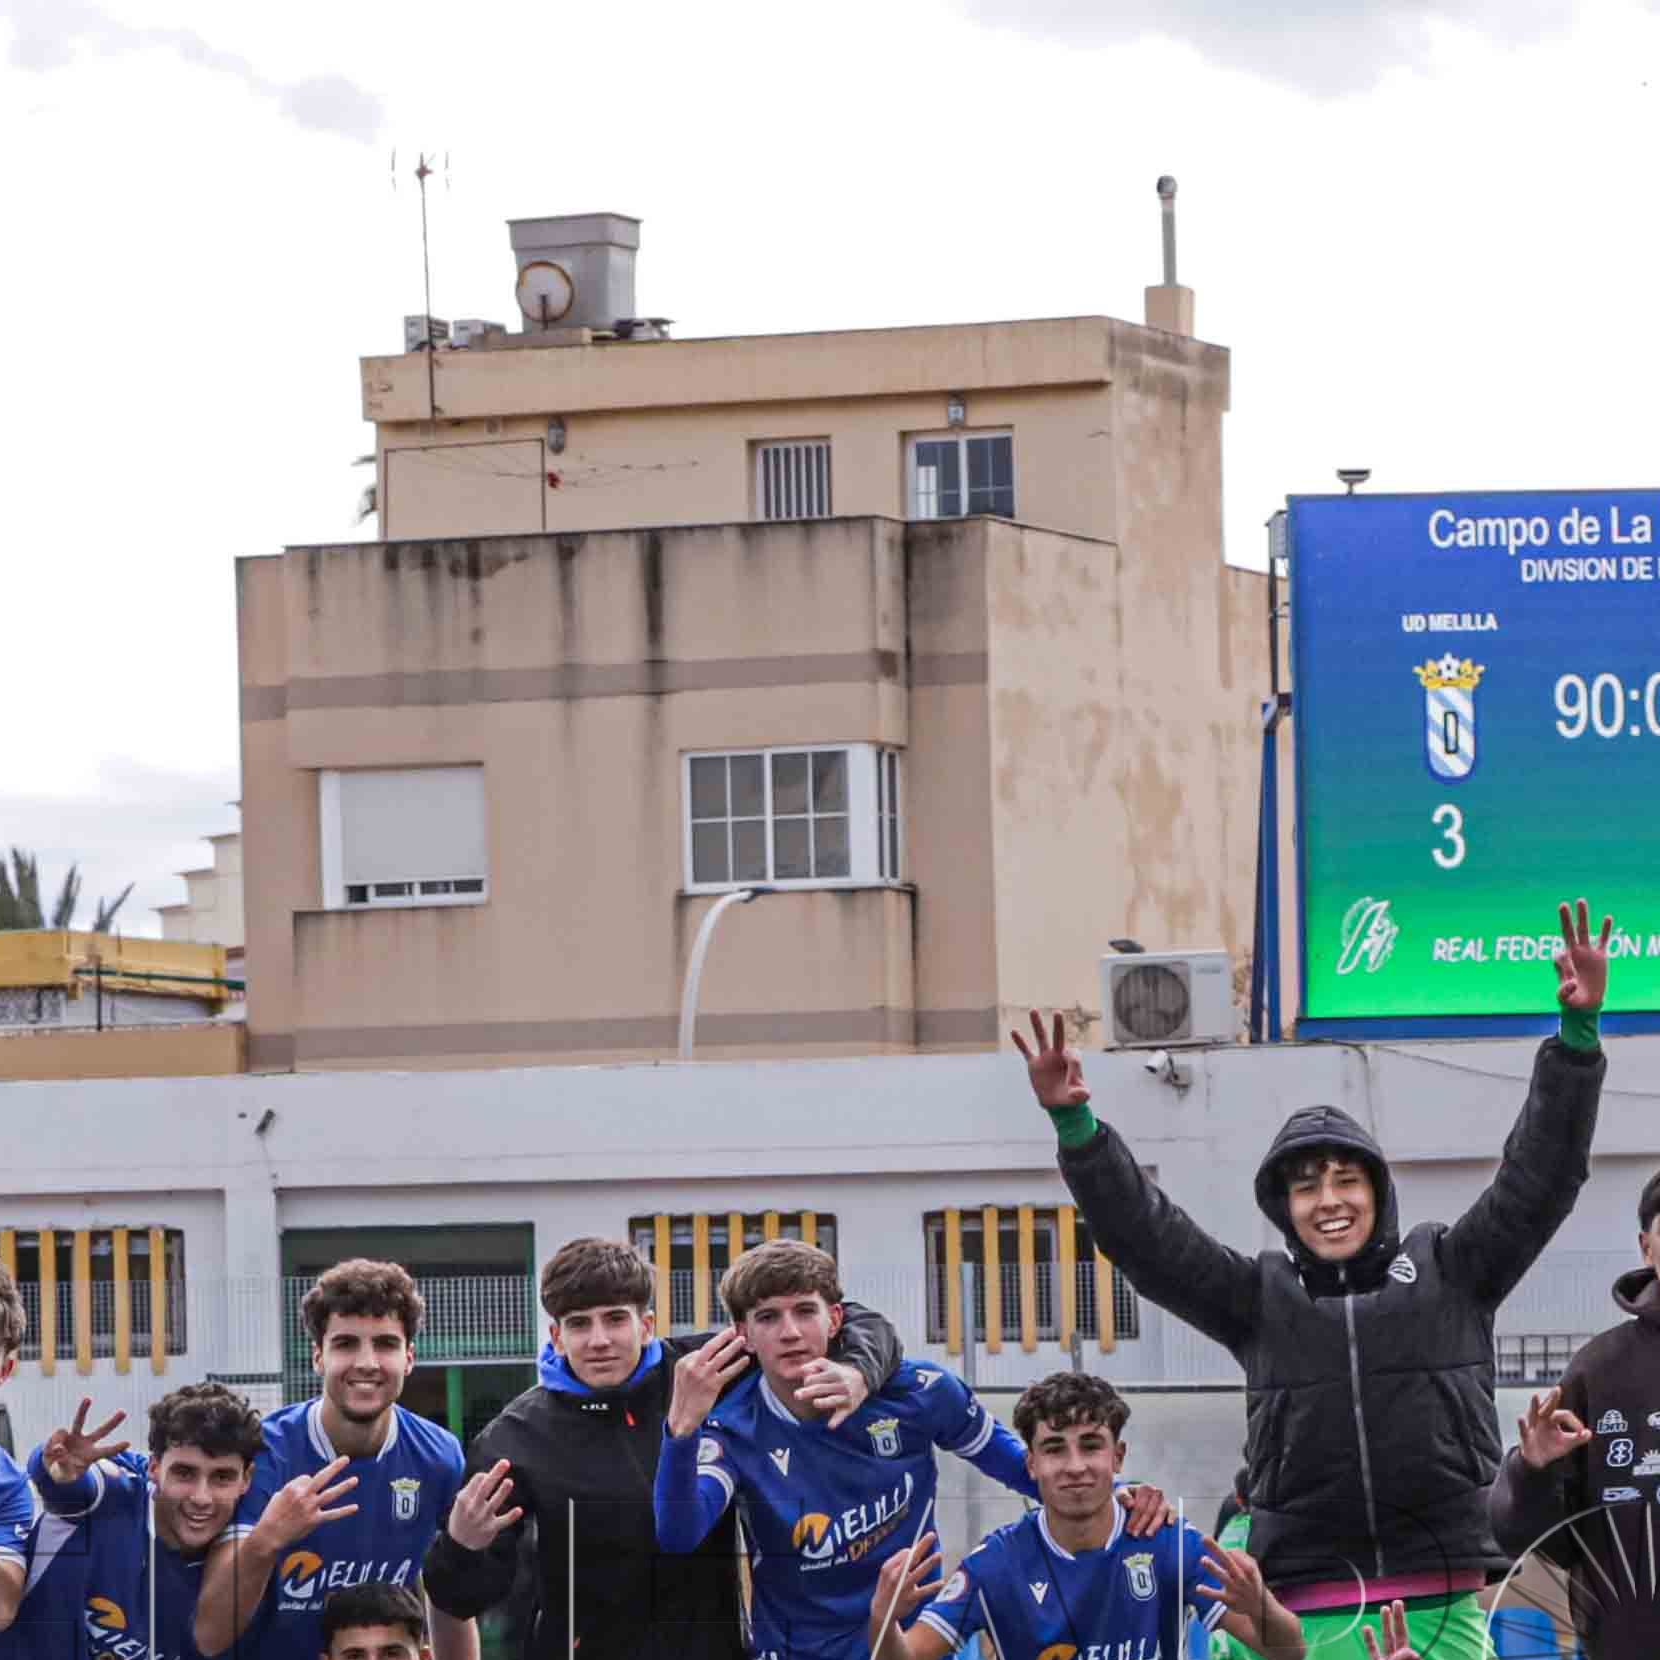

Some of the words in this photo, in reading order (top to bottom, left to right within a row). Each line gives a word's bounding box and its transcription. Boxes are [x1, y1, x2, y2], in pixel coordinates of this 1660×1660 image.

[1428, 508, 1549, 555] Campo
[1558, 507, 1601, 546] de
[1611, 505, 1652, 544] La
[1521, 556, 1617, 583] DIVISION
[1622, 555, 1653, 581] DE
[1402, 612, 1427, 632] UD
[1428, 611, 1499, 632] MELILLA
[1432, 803, 1466, 869] 3
[1433, 935, 1489, 963] REAL
[1495, 928, 1641, 962] FEDERÓN
